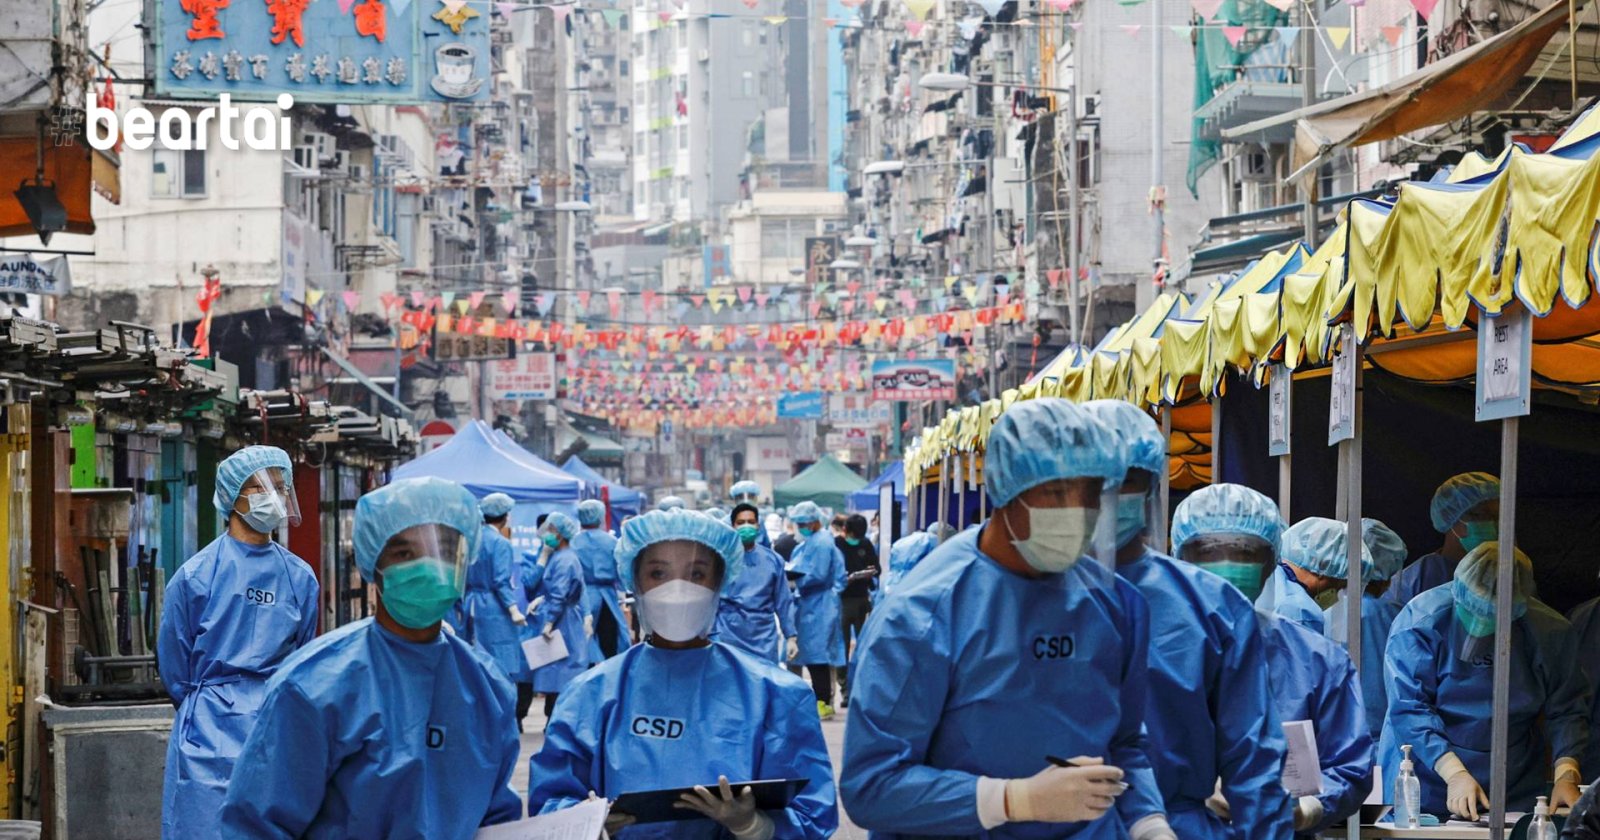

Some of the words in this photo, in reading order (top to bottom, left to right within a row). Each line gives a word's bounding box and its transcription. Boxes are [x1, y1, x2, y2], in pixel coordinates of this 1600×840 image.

[1493, 357, 1509, 377] AREA
[246, 587, 275, 604] CSD
[1033, 635, 1074, 660] CSD
[1471, 654, 1494, 666] CS
[427, 727, 445, 748] D
[631, 716, 684, 739] CSD
